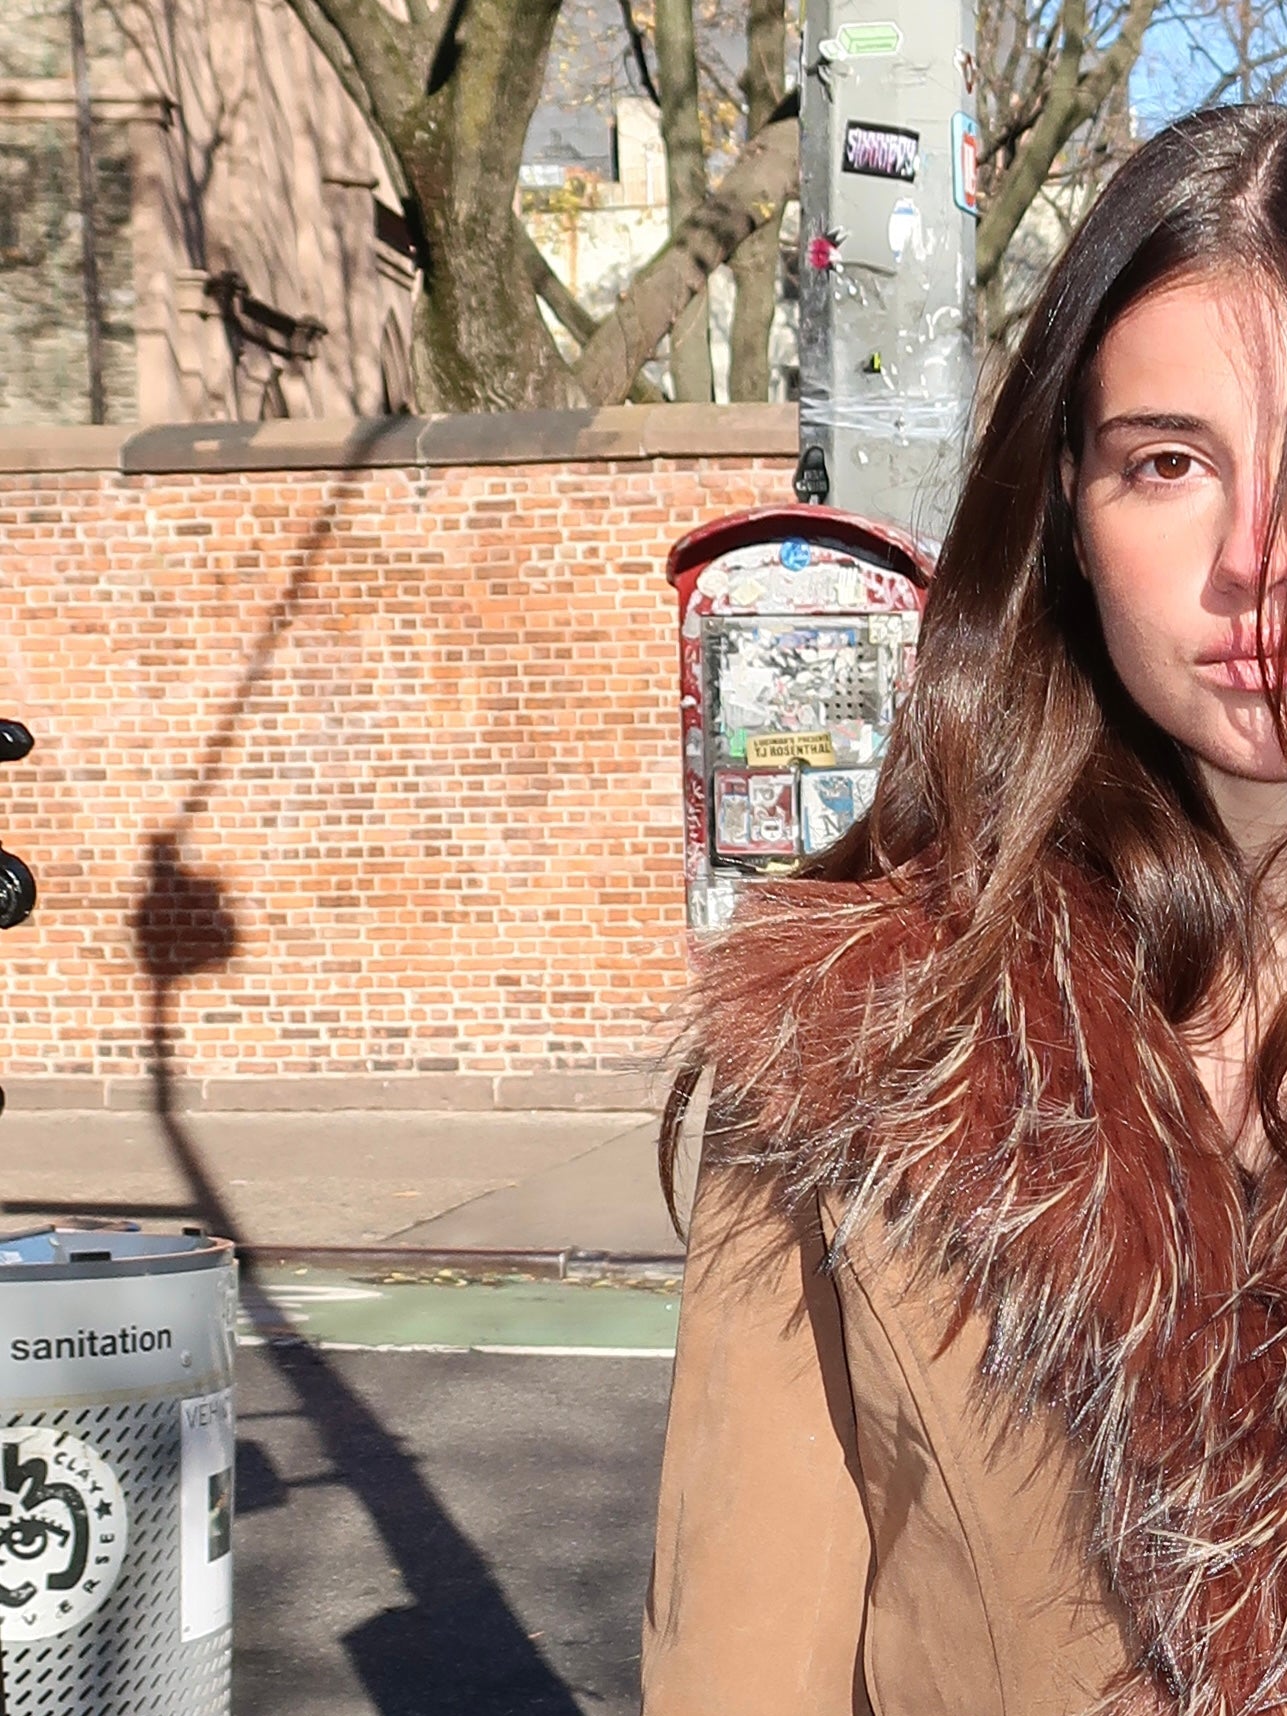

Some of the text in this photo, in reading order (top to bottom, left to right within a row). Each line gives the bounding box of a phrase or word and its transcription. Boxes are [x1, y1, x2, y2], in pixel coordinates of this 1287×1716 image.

[770, 743, 831, 757] ROSENTHAL
[11, 1325, 172, 1361] sanitation
[54, 1451, 104, 1495] CLAY
